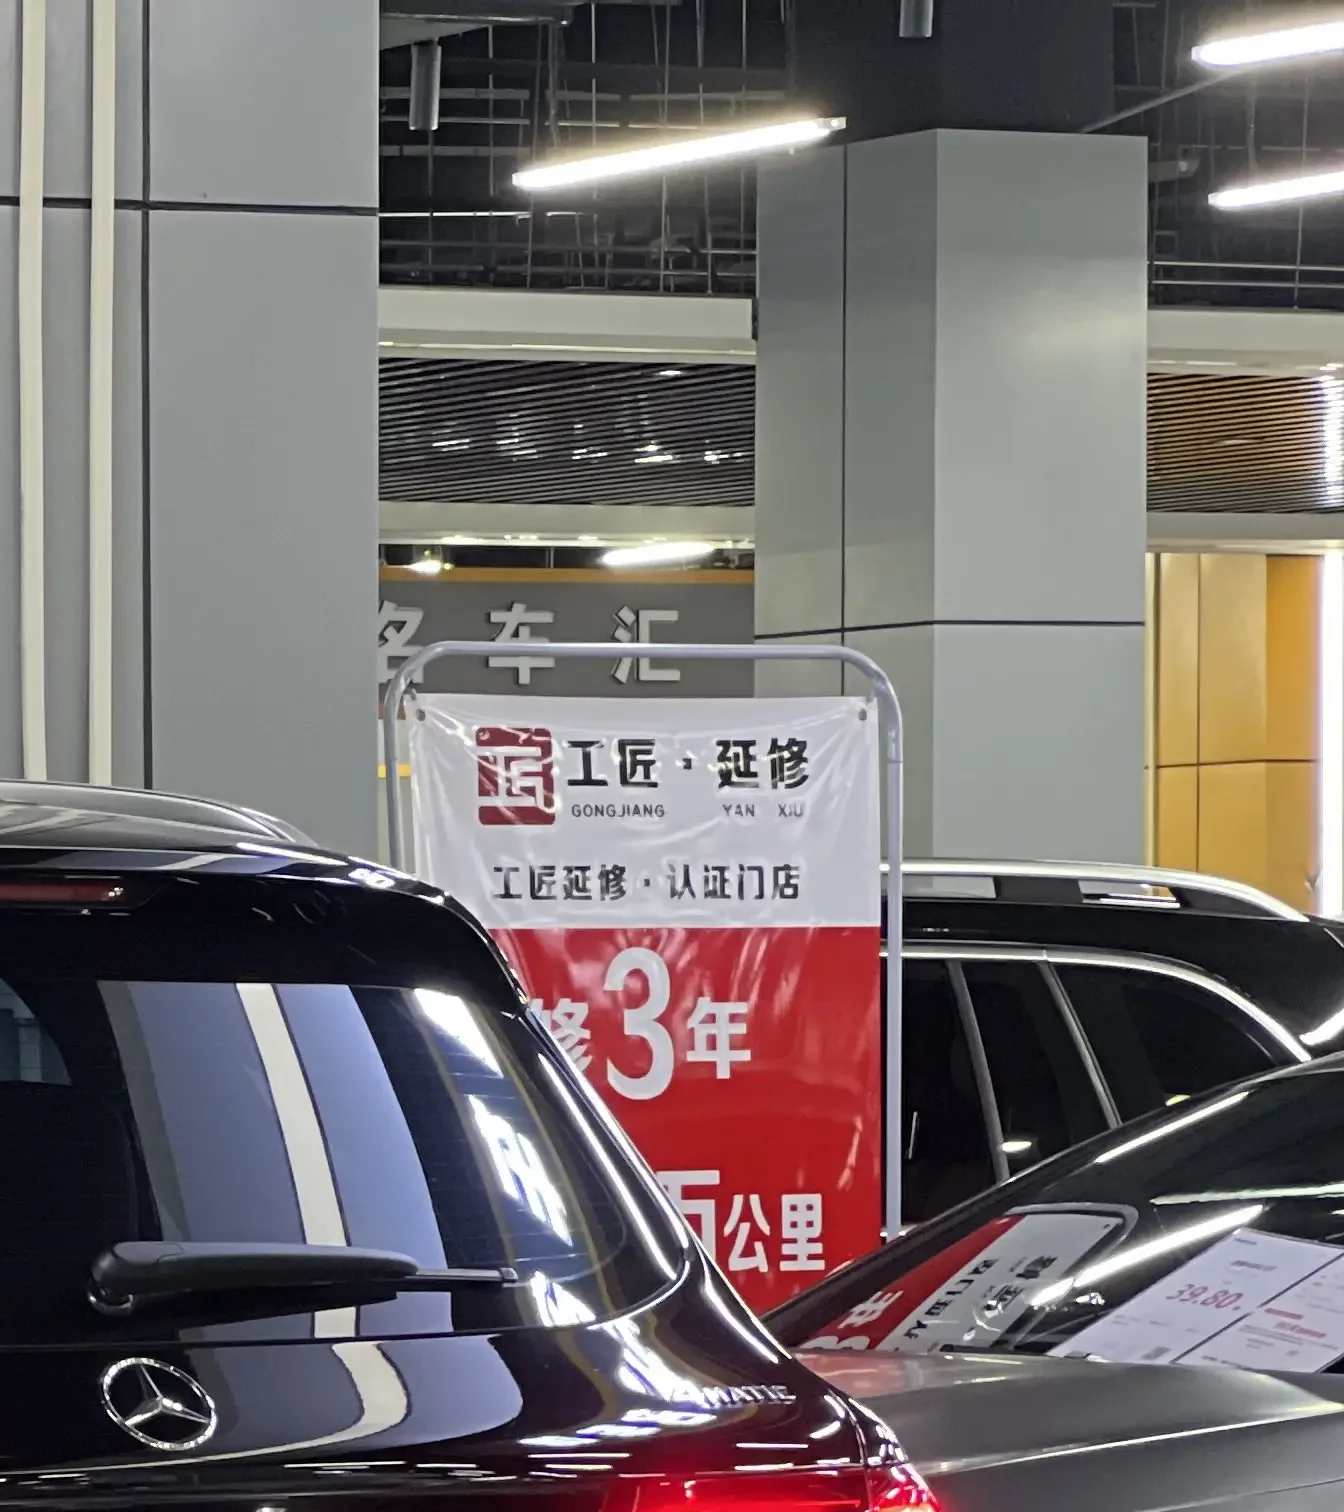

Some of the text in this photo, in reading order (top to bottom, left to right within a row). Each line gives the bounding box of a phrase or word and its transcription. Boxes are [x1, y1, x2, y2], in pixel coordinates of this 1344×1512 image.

[571, 803, 805, 819] GONGJIANG YAN XIU
